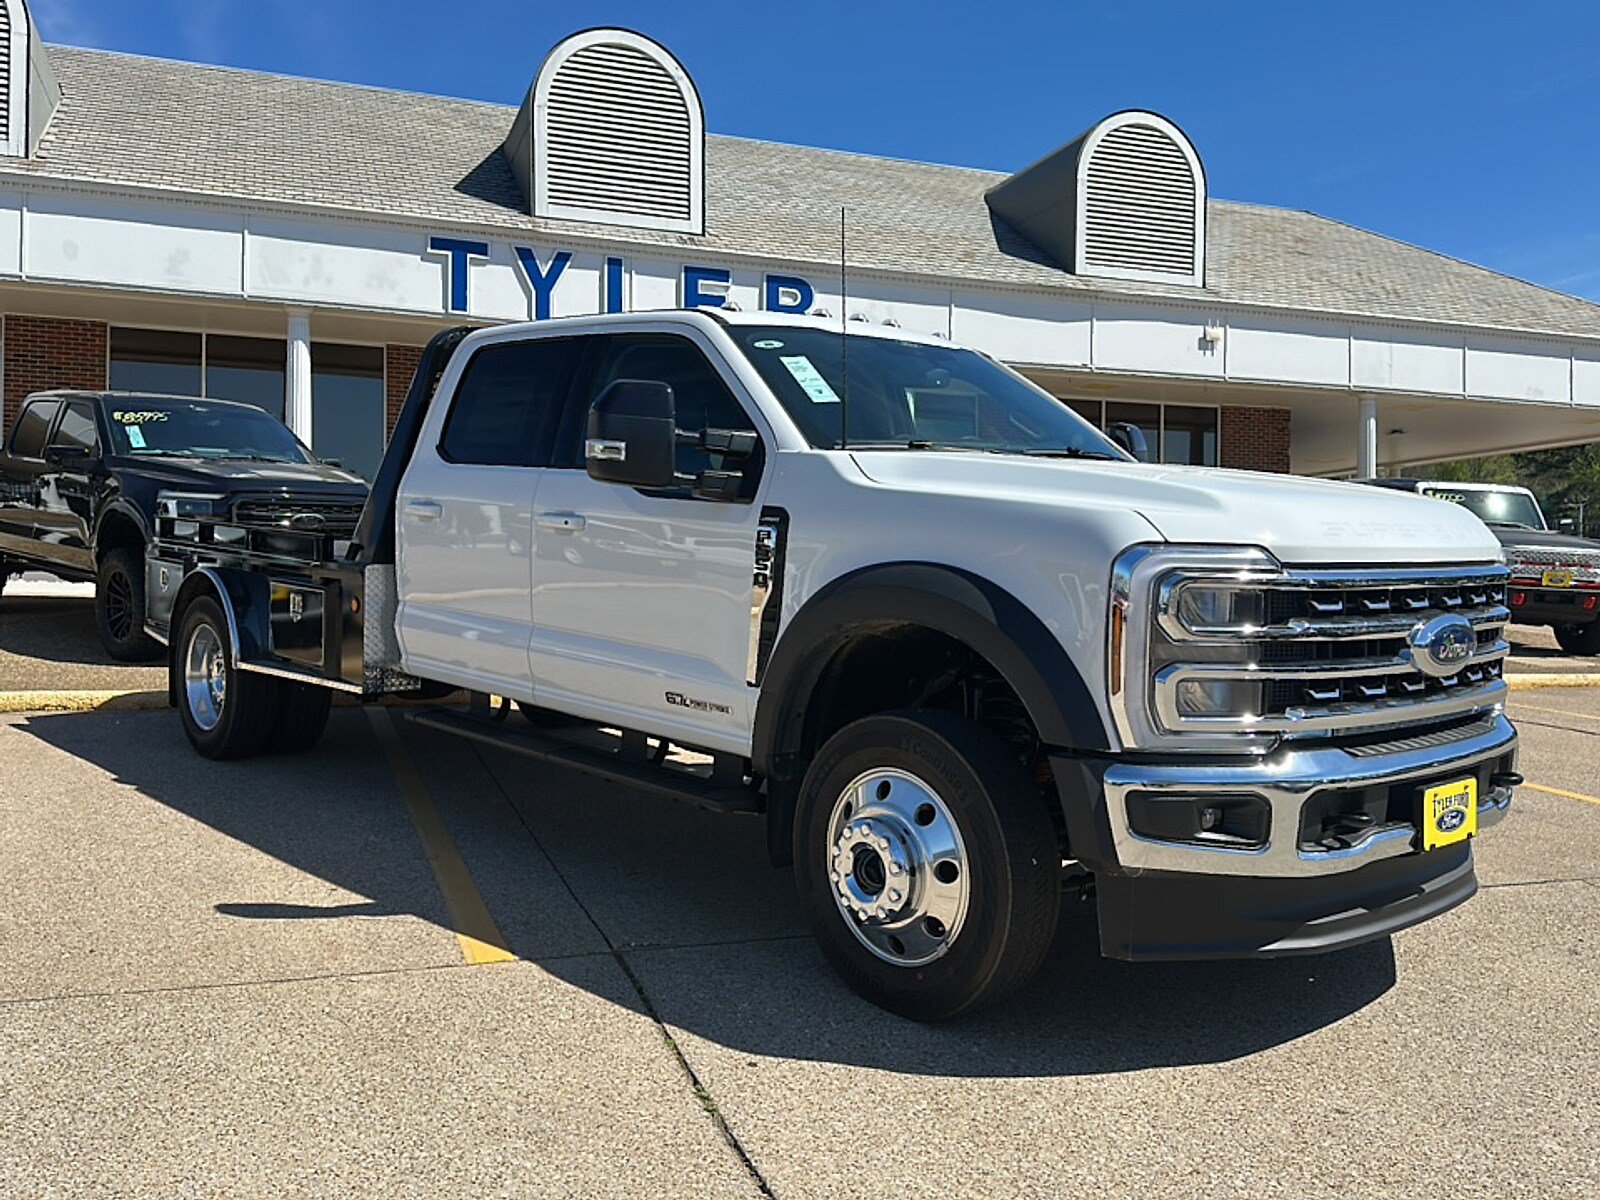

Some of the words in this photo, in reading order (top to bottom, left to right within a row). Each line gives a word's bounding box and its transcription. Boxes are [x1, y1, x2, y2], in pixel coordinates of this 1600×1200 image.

[1439, 633, 1467, 659] Ford
[665, 691, 690, 707] 6.7L
[1432, 795, 1453, 818] TYLER
[1453, 791, 1469, 809] FORD
